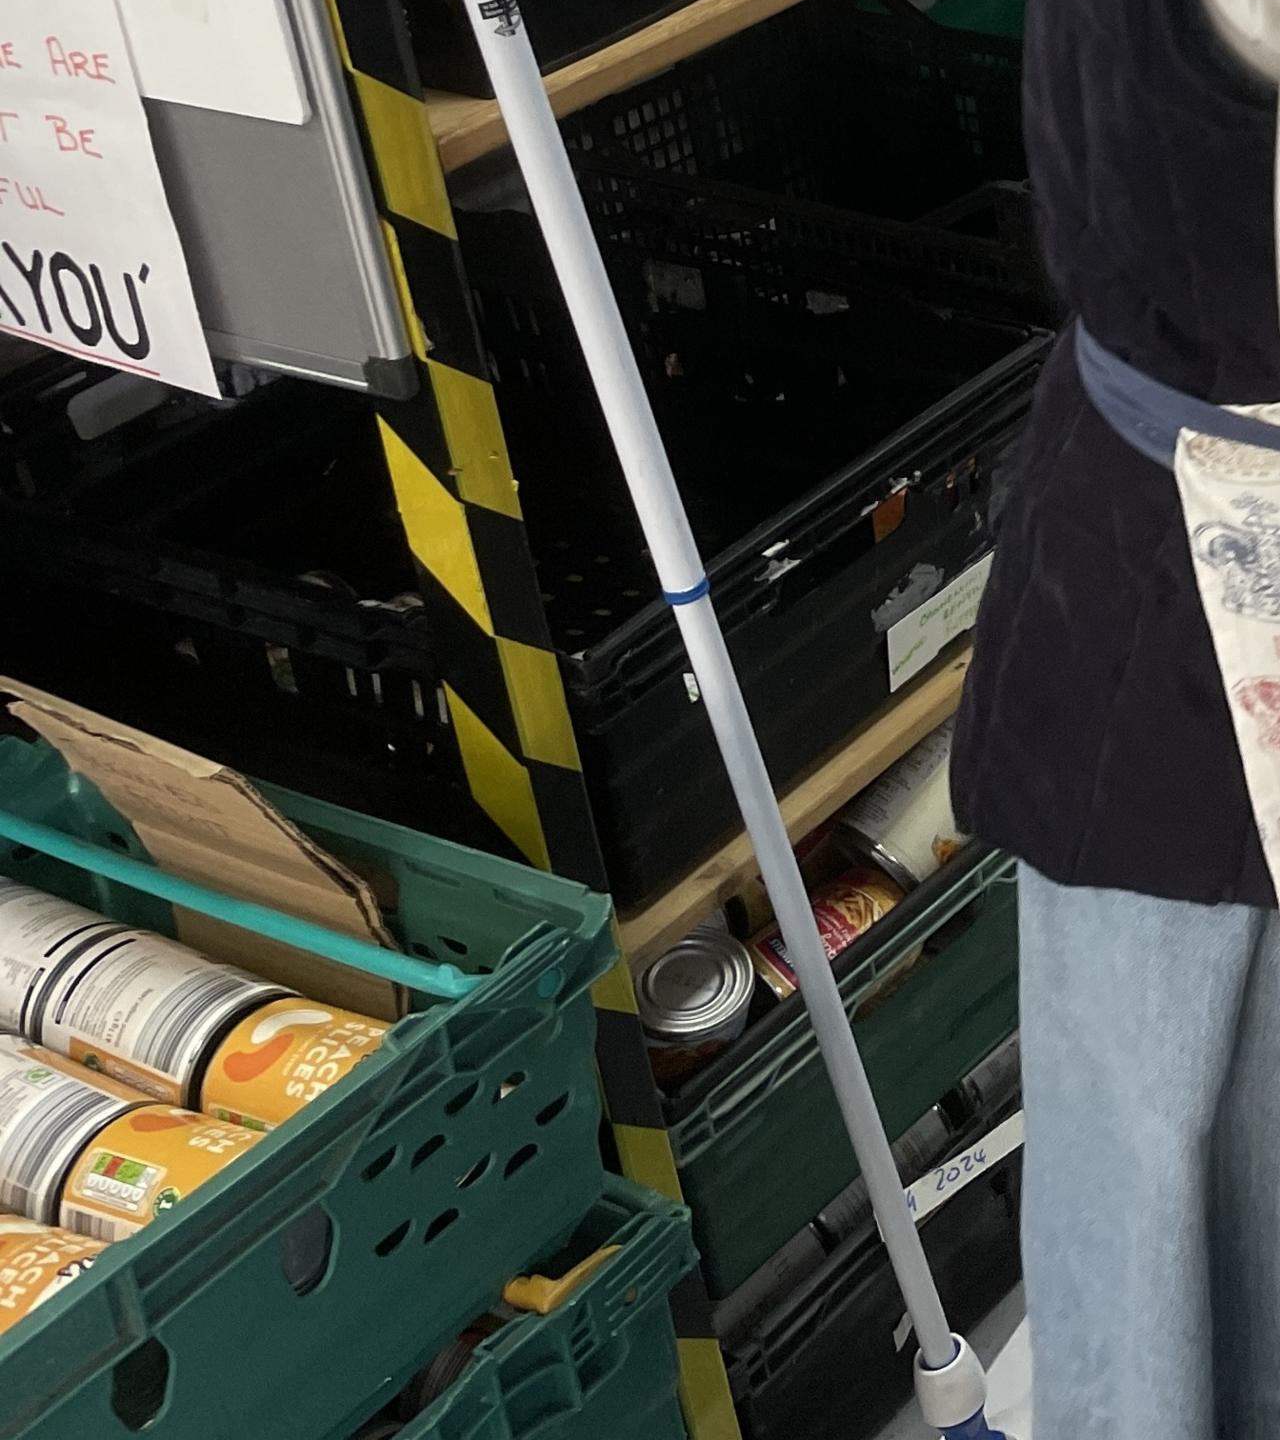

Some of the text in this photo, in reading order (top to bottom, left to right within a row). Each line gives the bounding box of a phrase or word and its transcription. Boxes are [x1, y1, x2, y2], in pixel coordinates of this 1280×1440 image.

[46, 36, 116, 84] ARE
[45, 114, 104, 160] BE
[284, 1021, 359, 1100] SLICES
[302, 1025, 386, 1102] PEACH
[934, 1148, 987, 1192] 2024
